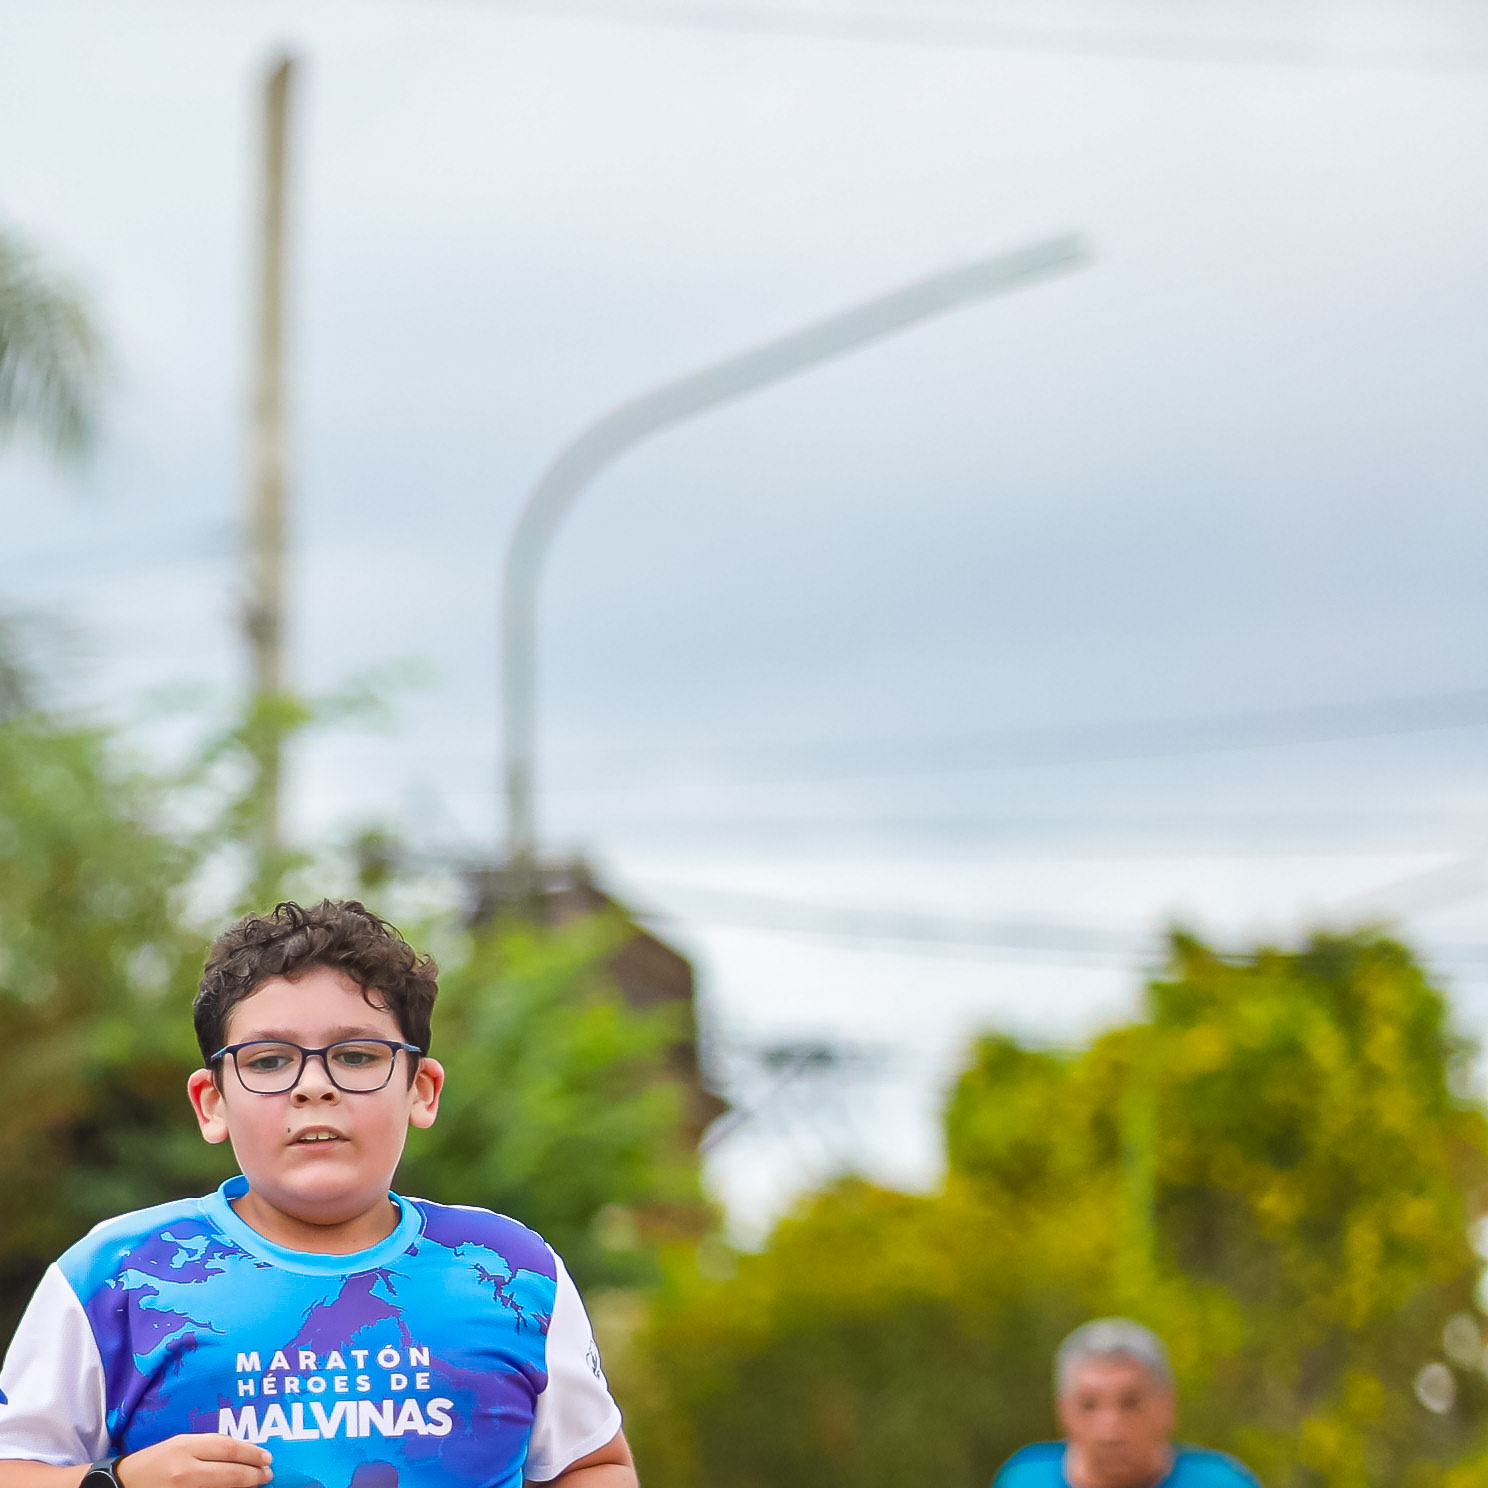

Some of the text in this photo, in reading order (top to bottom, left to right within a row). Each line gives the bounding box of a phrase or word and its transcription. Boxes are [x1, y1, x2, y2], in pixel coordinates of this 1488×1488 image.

[236, 1344, 431, 1373] MARATÓN
[237, 1372, 431, 1397] HÉROES DE
[218, 1397, 455, 1444] MALVINAS
